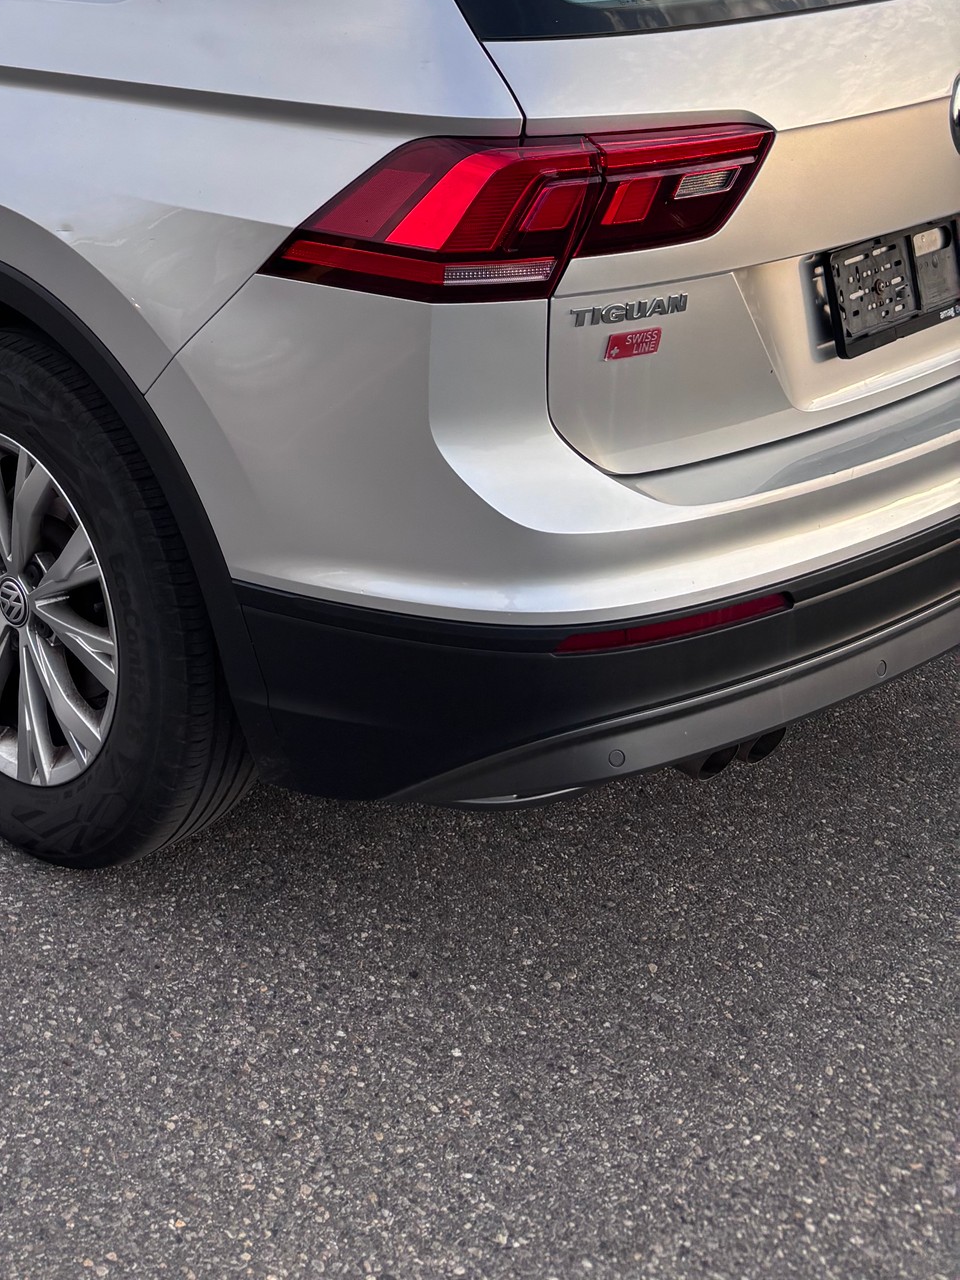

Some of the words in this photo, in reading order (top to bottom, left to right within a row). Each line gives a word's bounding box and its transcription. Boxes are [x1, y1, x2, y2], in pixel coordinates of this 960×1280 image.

[570, 293, 688, 327] TIGUAN
[626, 330, 658, 345] SWISS
[633, 341, 656, 354] LINE
